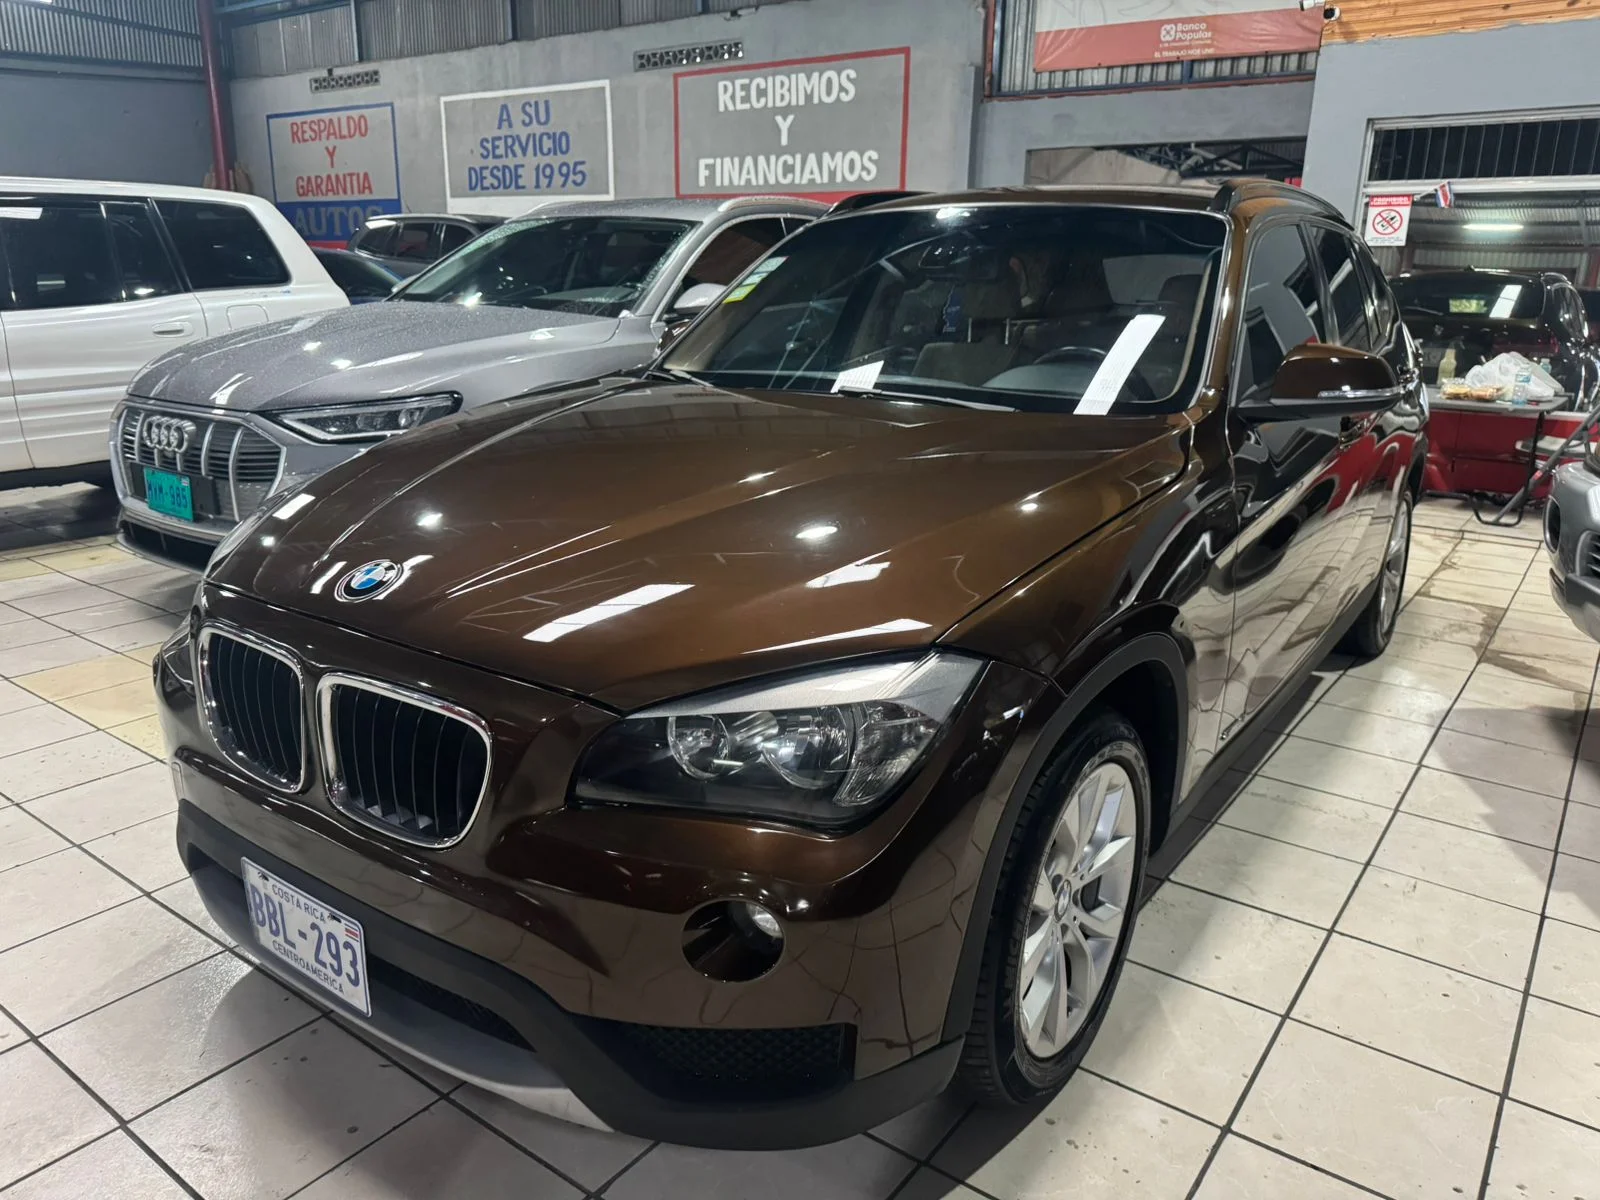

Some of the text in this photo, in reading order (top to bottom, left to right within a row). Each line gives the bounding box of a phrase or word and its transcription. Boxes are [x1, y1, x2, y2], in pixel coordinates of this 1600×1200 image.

[1176, 31, 1212, 40] Popular
[1177, 23, 1207, 31] Banco
[718, 68, 857, 112] RECIBIMOS
[290, 114, 369, 144] RESPALDO
[497, 100, 550, 130] A SU
[774, 114, 796, 146] Y
[324, 146, 337, 169] Y
[479, 131, 571, 160] SERVICIO
[468, 161, 587, 192] DESDE 1995
[698, 150, 879, 188] FINANCIAMOS
[295, 172, 373, 197] GARANTIA
[272, 884, 326, 924] COSTA RICA
[250, 884, 360, 988] BBL-293
[272, 940, 345, 995] CENTROAMERICA
